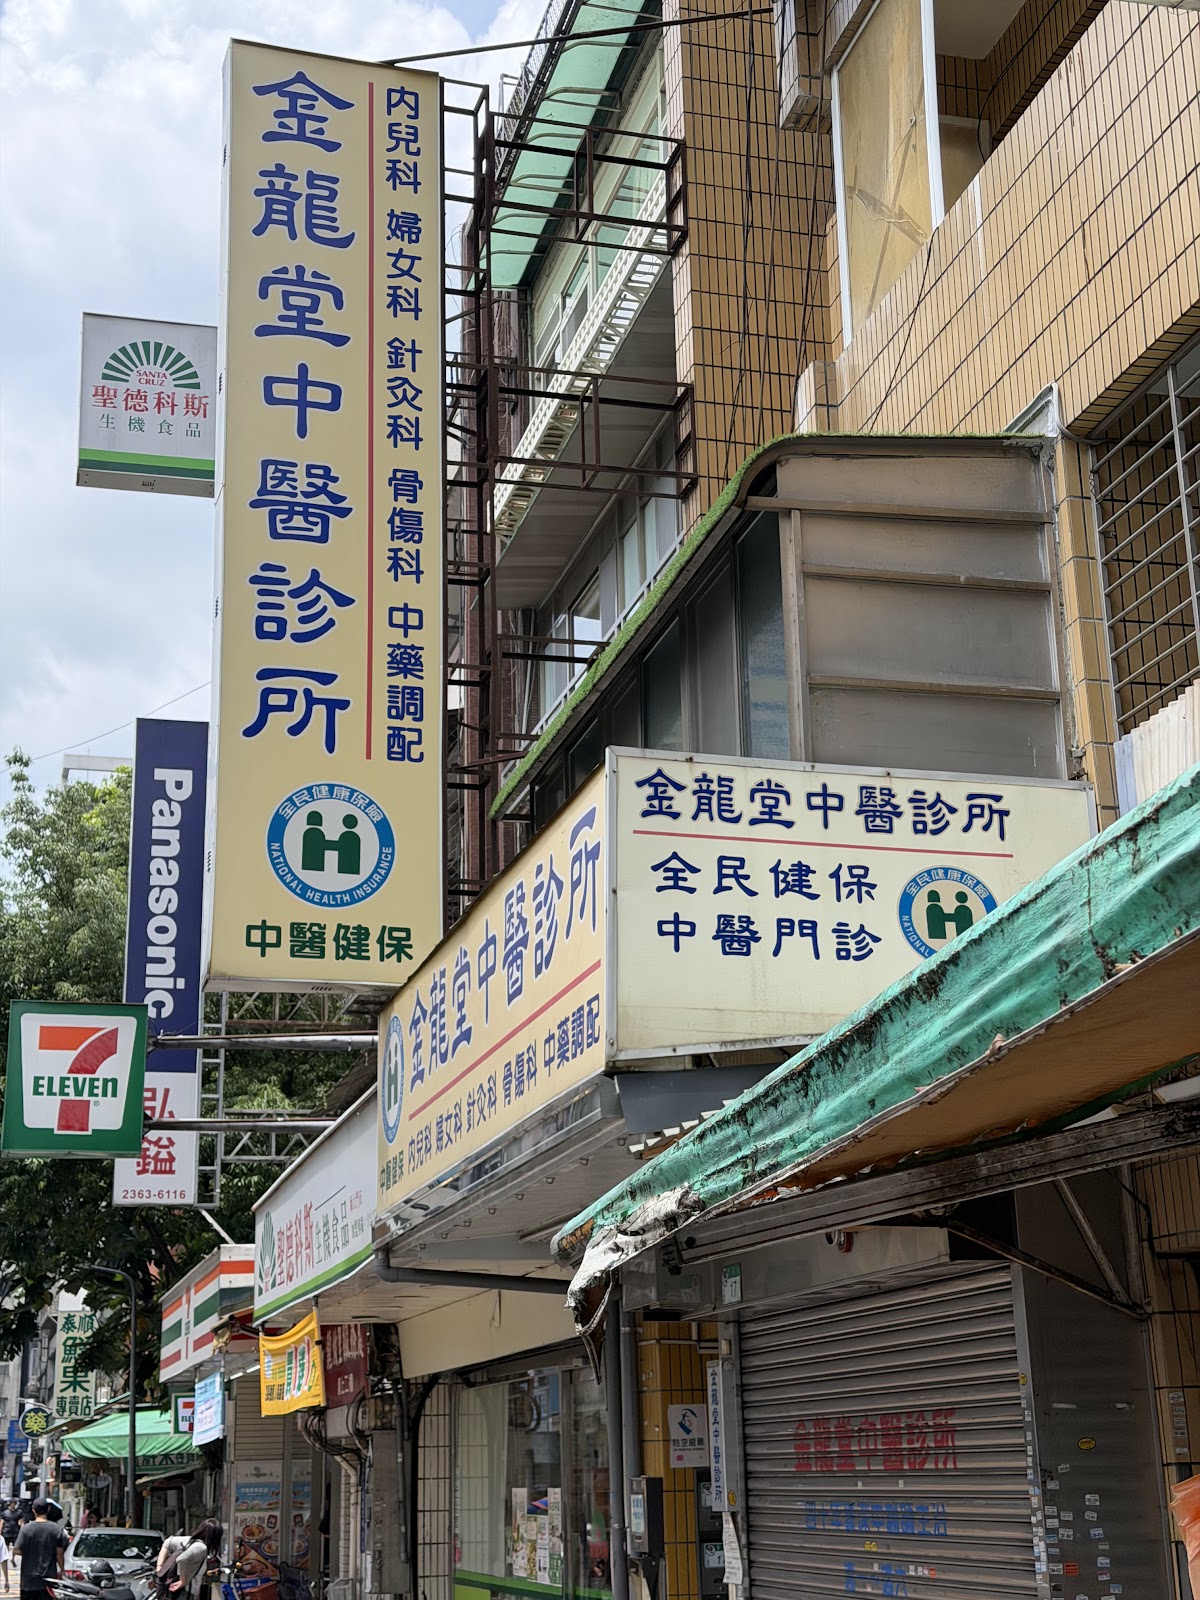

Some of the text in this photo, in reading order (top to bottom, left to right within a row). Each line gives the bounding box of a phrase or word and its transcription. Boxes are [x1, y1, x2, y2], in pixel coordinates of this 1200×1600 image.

[135, 369, 168, 380] SANTA
[137, 377, 166, 387] CRUZ
[91, 384, 210, 419] 聖德科斯
[98, 413, 201, 438] 生機食品
[242, 71, 355, 754] 金龍堂中醫診所
[386, 86, 424, 763] 內兒科 婦女科 針灸科 骨傷科 中藥調配
[278, 784, 384, 824] 全民健康保險
[635, 767, 1011, 841] 金龍堂中醫診所
[144, 768, 194, 1019] Panasonic
[270, 842, 392, 905] NATIONAL HEALTH INSURANCE
[650, 851, 878, 904] 全民健保
[246, 919, 414, 964] 中醫健保
[408, 806, 601, 1095] 金龍堂中醫診所
[656, 912, 882, 962] 中醫門診
[901, 915, 930, 957] NATIONAL
[38, 1025, 119, 1132] 7
[407, 1119, 433, 1175] 內兒科
[435, 1097, 462, 1155] 婦女科
[466, 1070, 498, 1134] 針灸科
[502, 1039, 538, 1108] 骨傷科
[543, 993, 601, 1077] 中藥調配
[122, 1189, 187, 1200] 2363-6116
[380, 1149, 404, 1197] 中醫健保
[276, 1199, 315, 1287] 聖德科斯
[315, 1200, 350, 1265] 生機食品
[60, 1313, 96, 1335] 泰順
[24, 1411, 48, 1434] 藥
[55, 1395, 92, 1417] 專賣店
